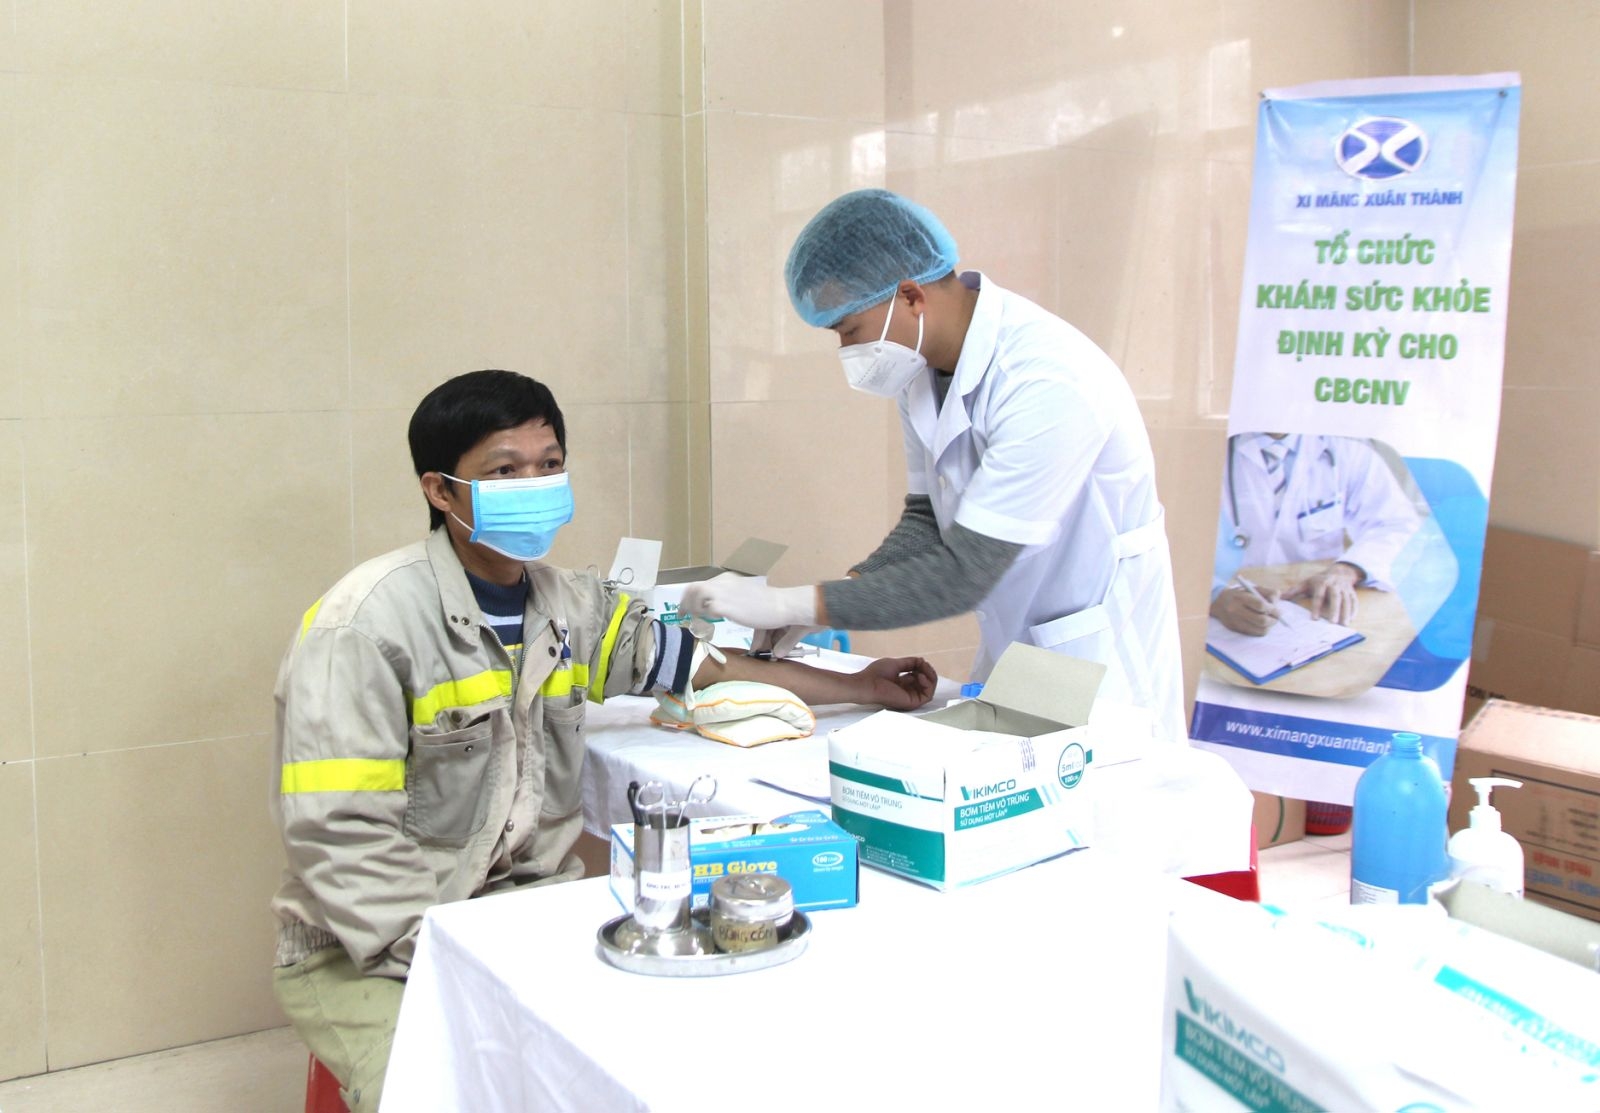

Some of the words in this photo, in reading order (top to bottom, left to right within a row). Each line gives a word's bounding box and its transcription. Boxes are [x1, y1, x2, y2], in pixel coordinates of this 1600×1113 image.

[1296, 194, 1311, 208] XI
[1314, 229, 1351, 265] TỔ
[1357, 233, 1436, 265] CHỨC
[1256, 279, 1338, 310] KHÁM
[1345, 280, 1404, 311] SỨC
[1412, 278, 1492, 313] KHỎE
[1277, 330, 1345, 362] ĐỊNH
[1353, 327, 1391, 358] KỲ
[1399, 333, 1458, 360] CHO
[1314, 377, 1411, 405] CBCNV
[960, 779, 1016, 801] VIKIMCO
[694, 863, 724, 877] HB
[727, 860, 777, 875] Glove
